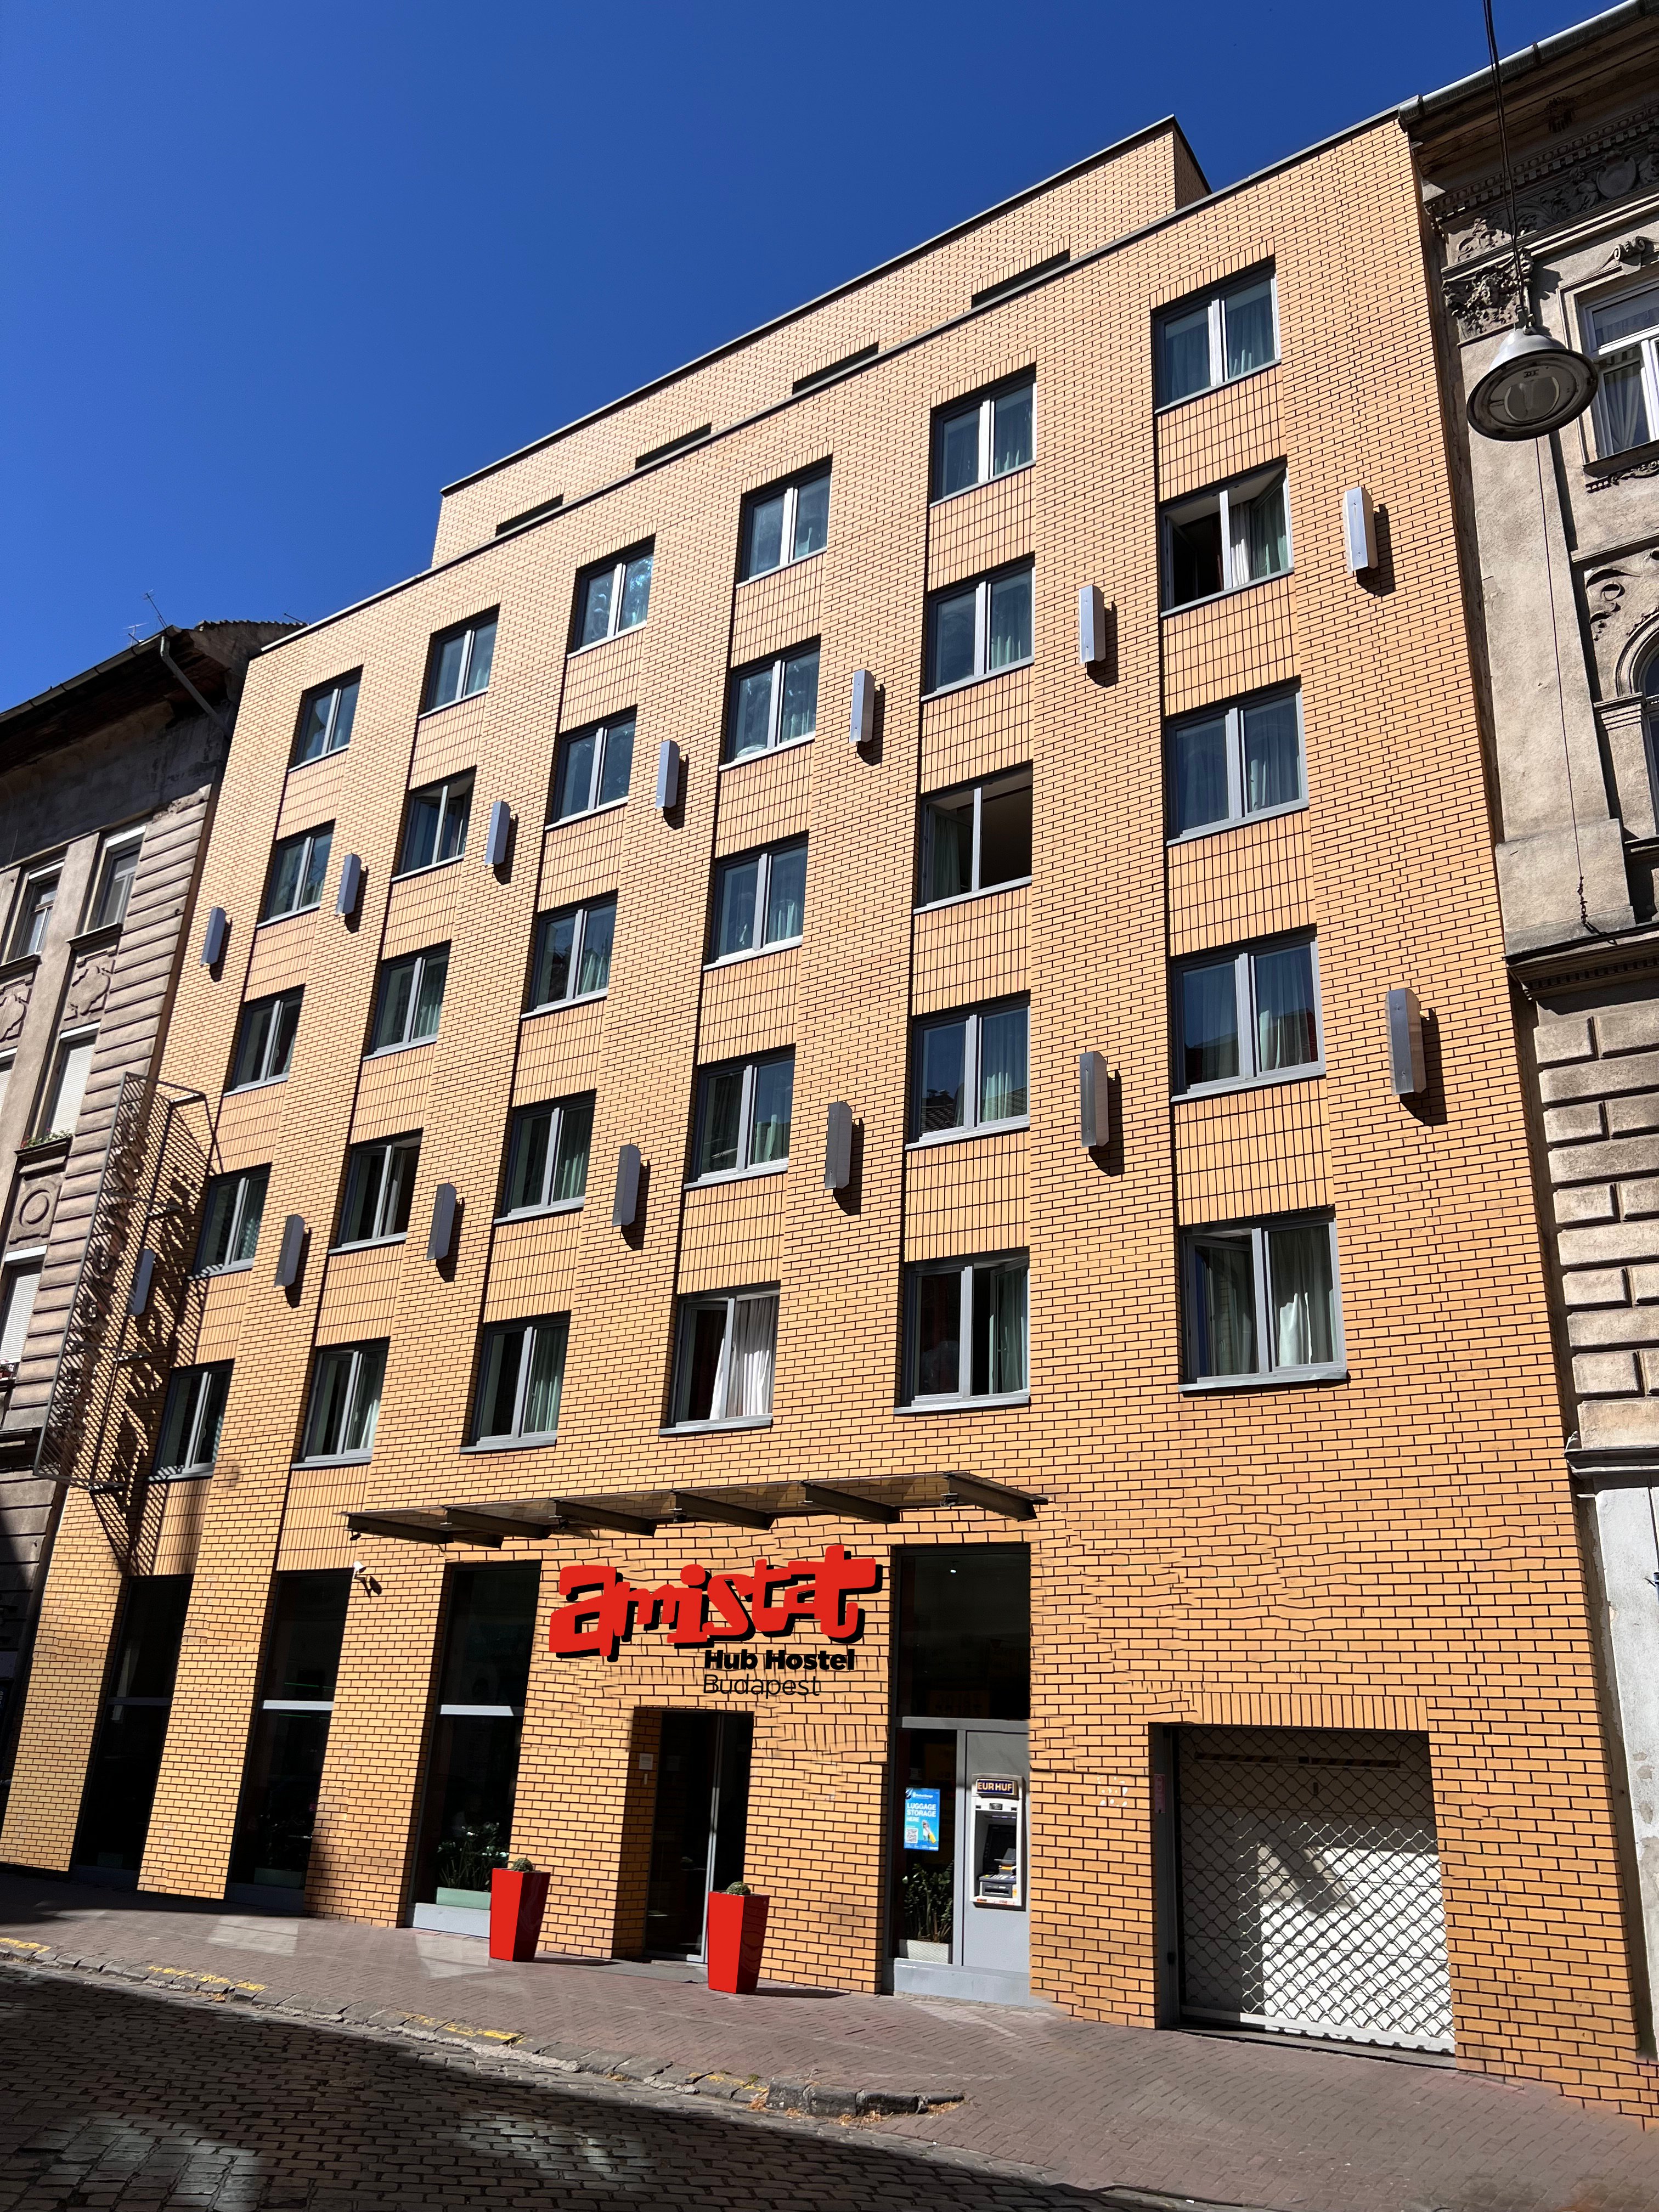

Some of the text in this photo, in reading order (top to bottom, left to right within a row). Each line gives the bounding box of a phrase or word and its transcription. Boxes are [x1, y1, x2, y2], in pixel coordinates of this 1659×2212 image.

[549, 1545, 882, 1662] amistat
[704, 1650, 855, 1671] Hub Hostel
[703, 1674, 820, 1699] Budapest
[978, 1782, 1012, 1791] EUR HUF
